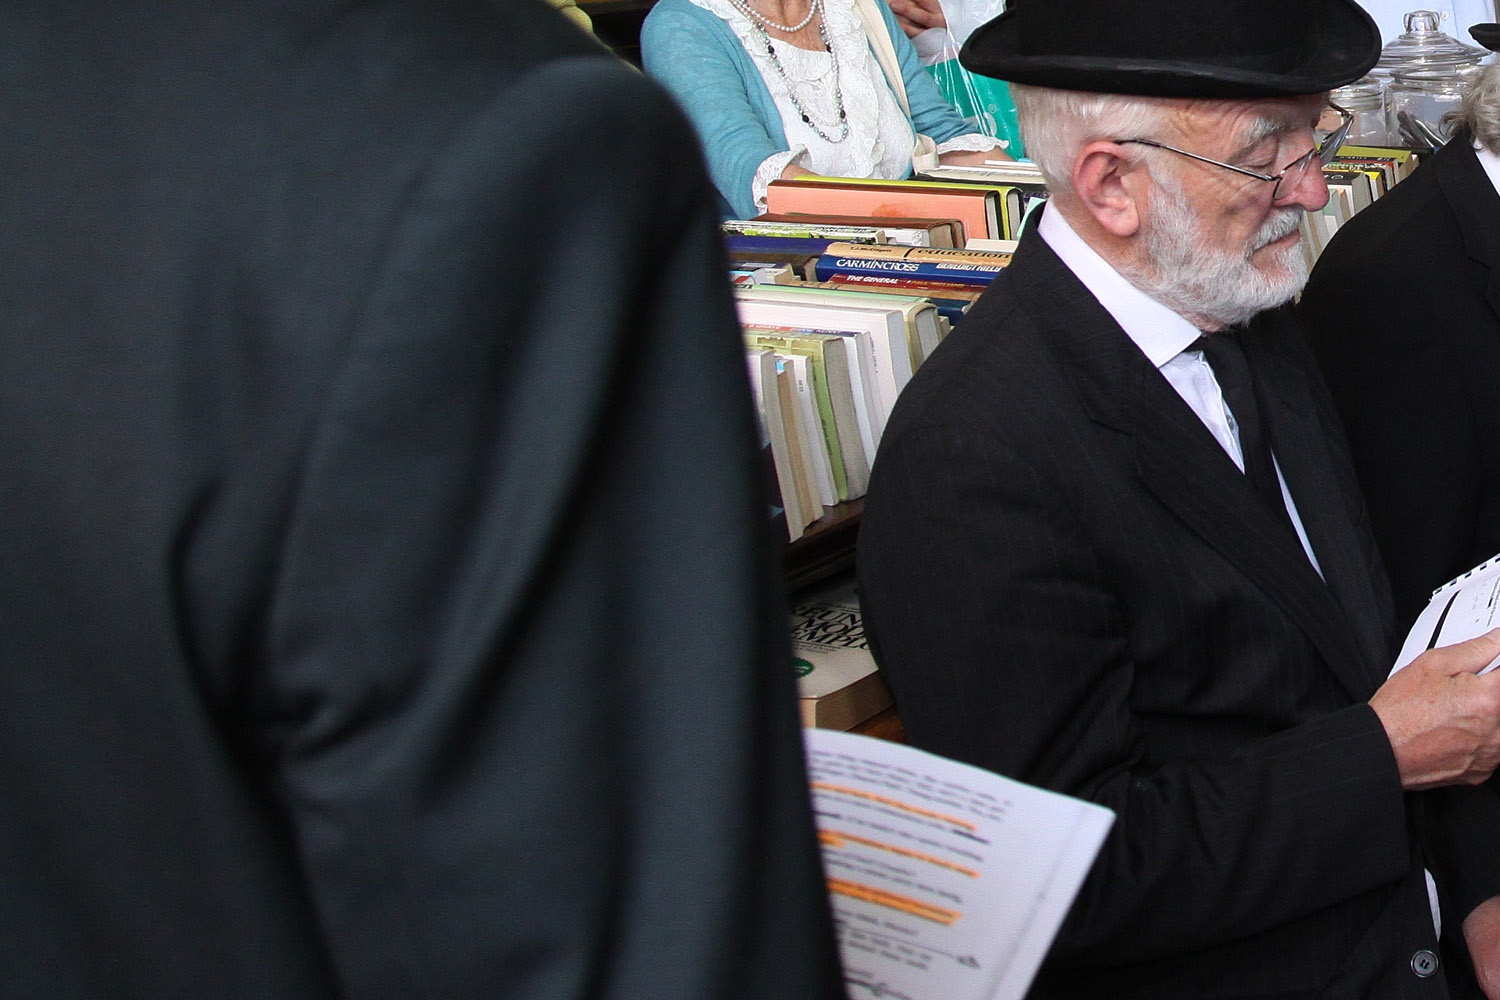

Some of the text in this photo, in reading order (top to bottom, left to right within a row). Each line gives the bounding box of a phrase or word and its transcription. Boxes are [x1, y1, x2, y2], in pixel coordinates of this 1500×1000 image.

[917, 247, 1011, 260] education
[836, 258, 920, 272] CARMINCROSS
[863, 276, 899, 285] GENERAL
